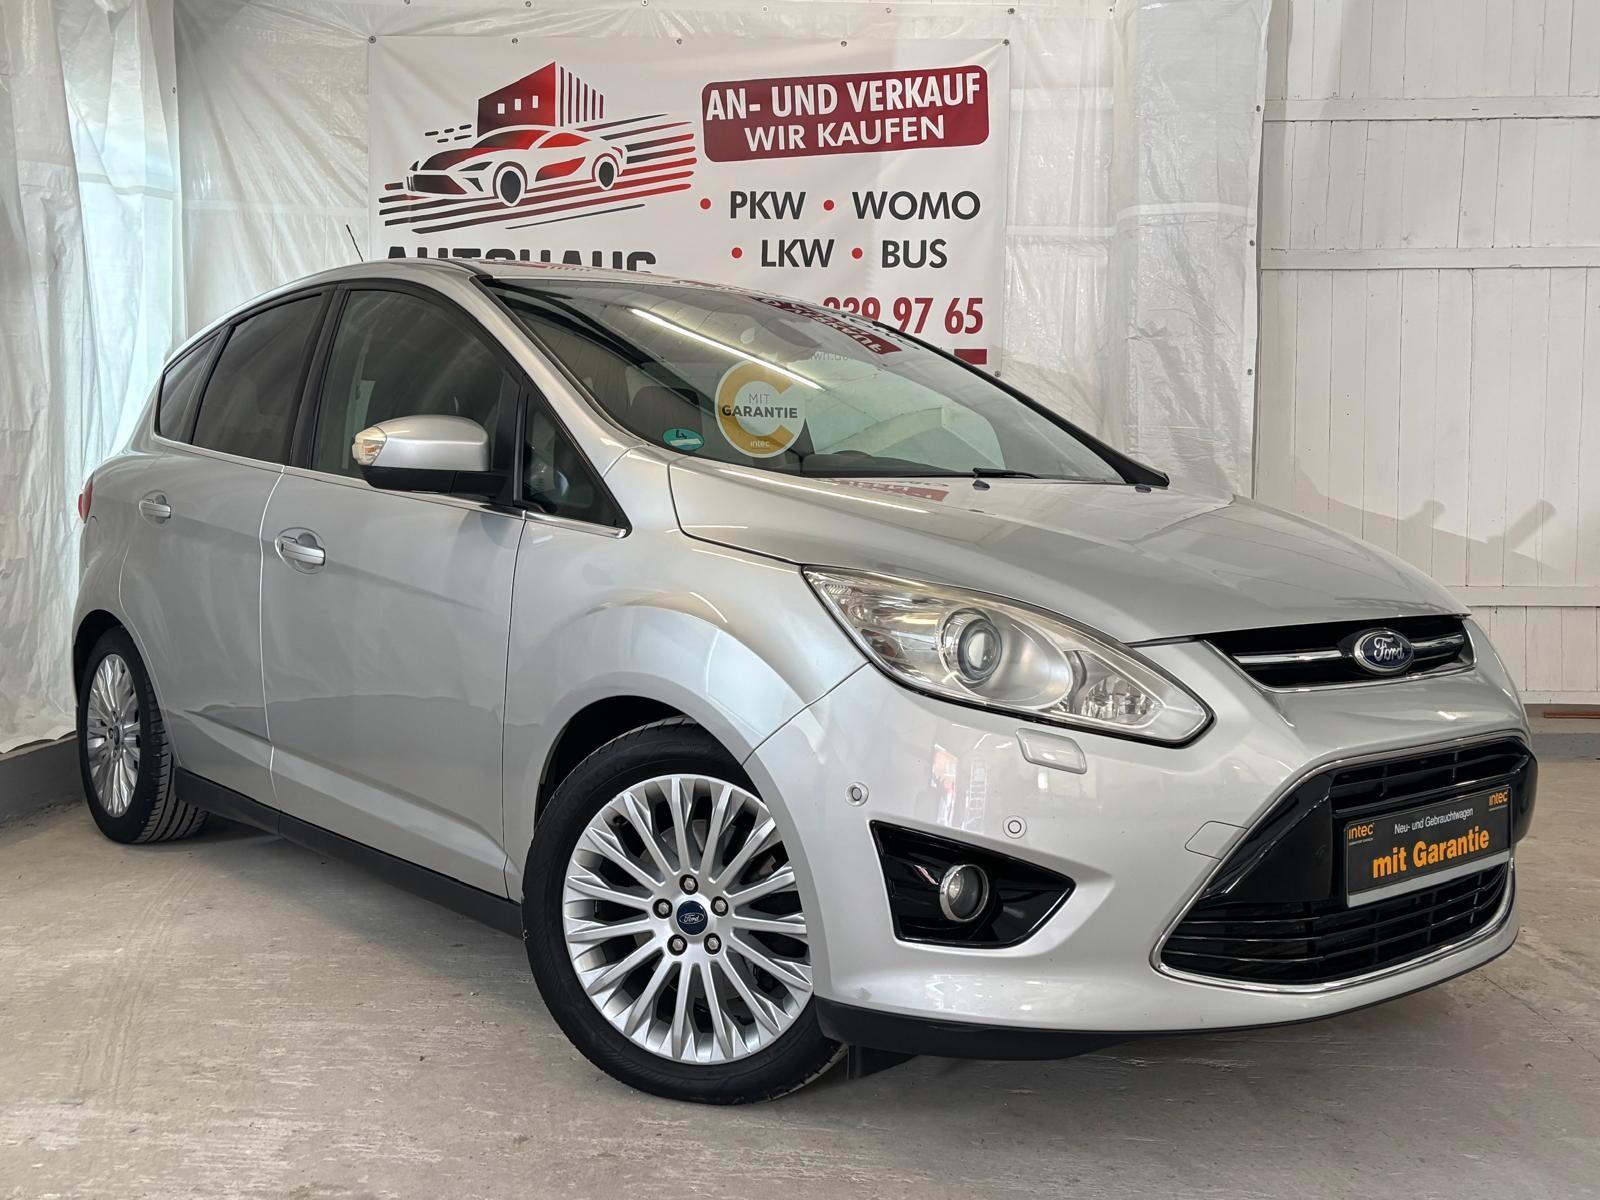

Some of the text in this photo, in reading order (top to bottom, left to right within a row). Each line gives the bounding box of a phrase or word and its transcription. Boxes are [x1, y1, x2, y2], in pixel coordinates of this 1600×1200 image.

[706, 73, 980, 121] AN- UND VERKAUF
[744, 115, 945, 152] WIR KAUFEN
[730, 191, 981, 220] PKW WOMO
[761, 239, 948, 268] LKW BUS
[893, 297, 934, 334] 97
[944, 297, 984, 334] 65
[721, 405, 798, 419] GARANTIE
[748, 393, 770, 404] MIT
[750, 440, 770, 448] intec
[1374, 637, 1405, 662] Ford
[1348, 824, 1374, 840] intec
[1394, 823, 1411, 835] Neu-
[1412, 818, 1424, 830] und
[1425, 808, 1474, 827] Gebrauchtwagen
[1372, 826, 1490, 878] mit Garantie
